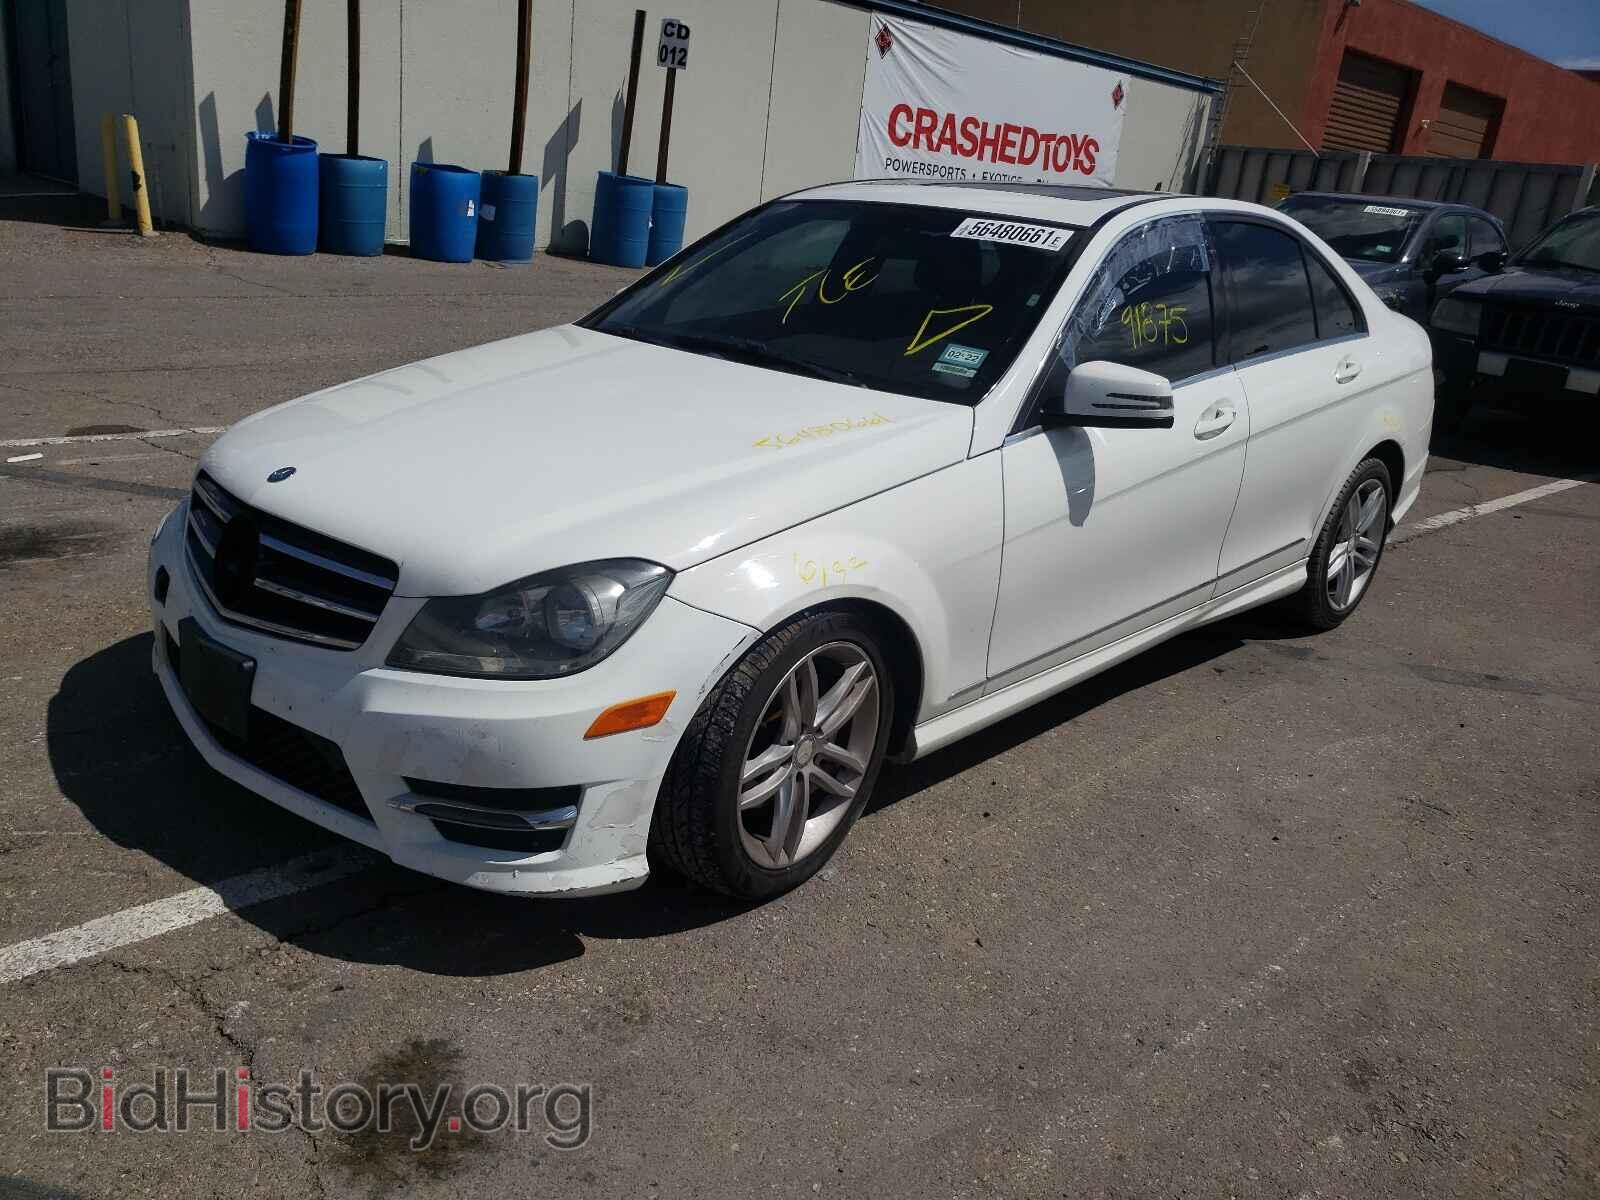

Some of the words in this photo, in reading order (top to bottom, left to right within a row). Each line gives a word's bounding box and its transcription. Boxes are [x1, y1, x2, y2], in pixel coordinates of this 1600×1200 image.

[664, 22, 690, 40] CD
[660, 45, 687, 66] 012
[888, 104, 1099, 175] CRASHEDTOYS
[885, 157, 966, 179] POWERSPORTS
[968, 222, 1055, 244] 56480661
